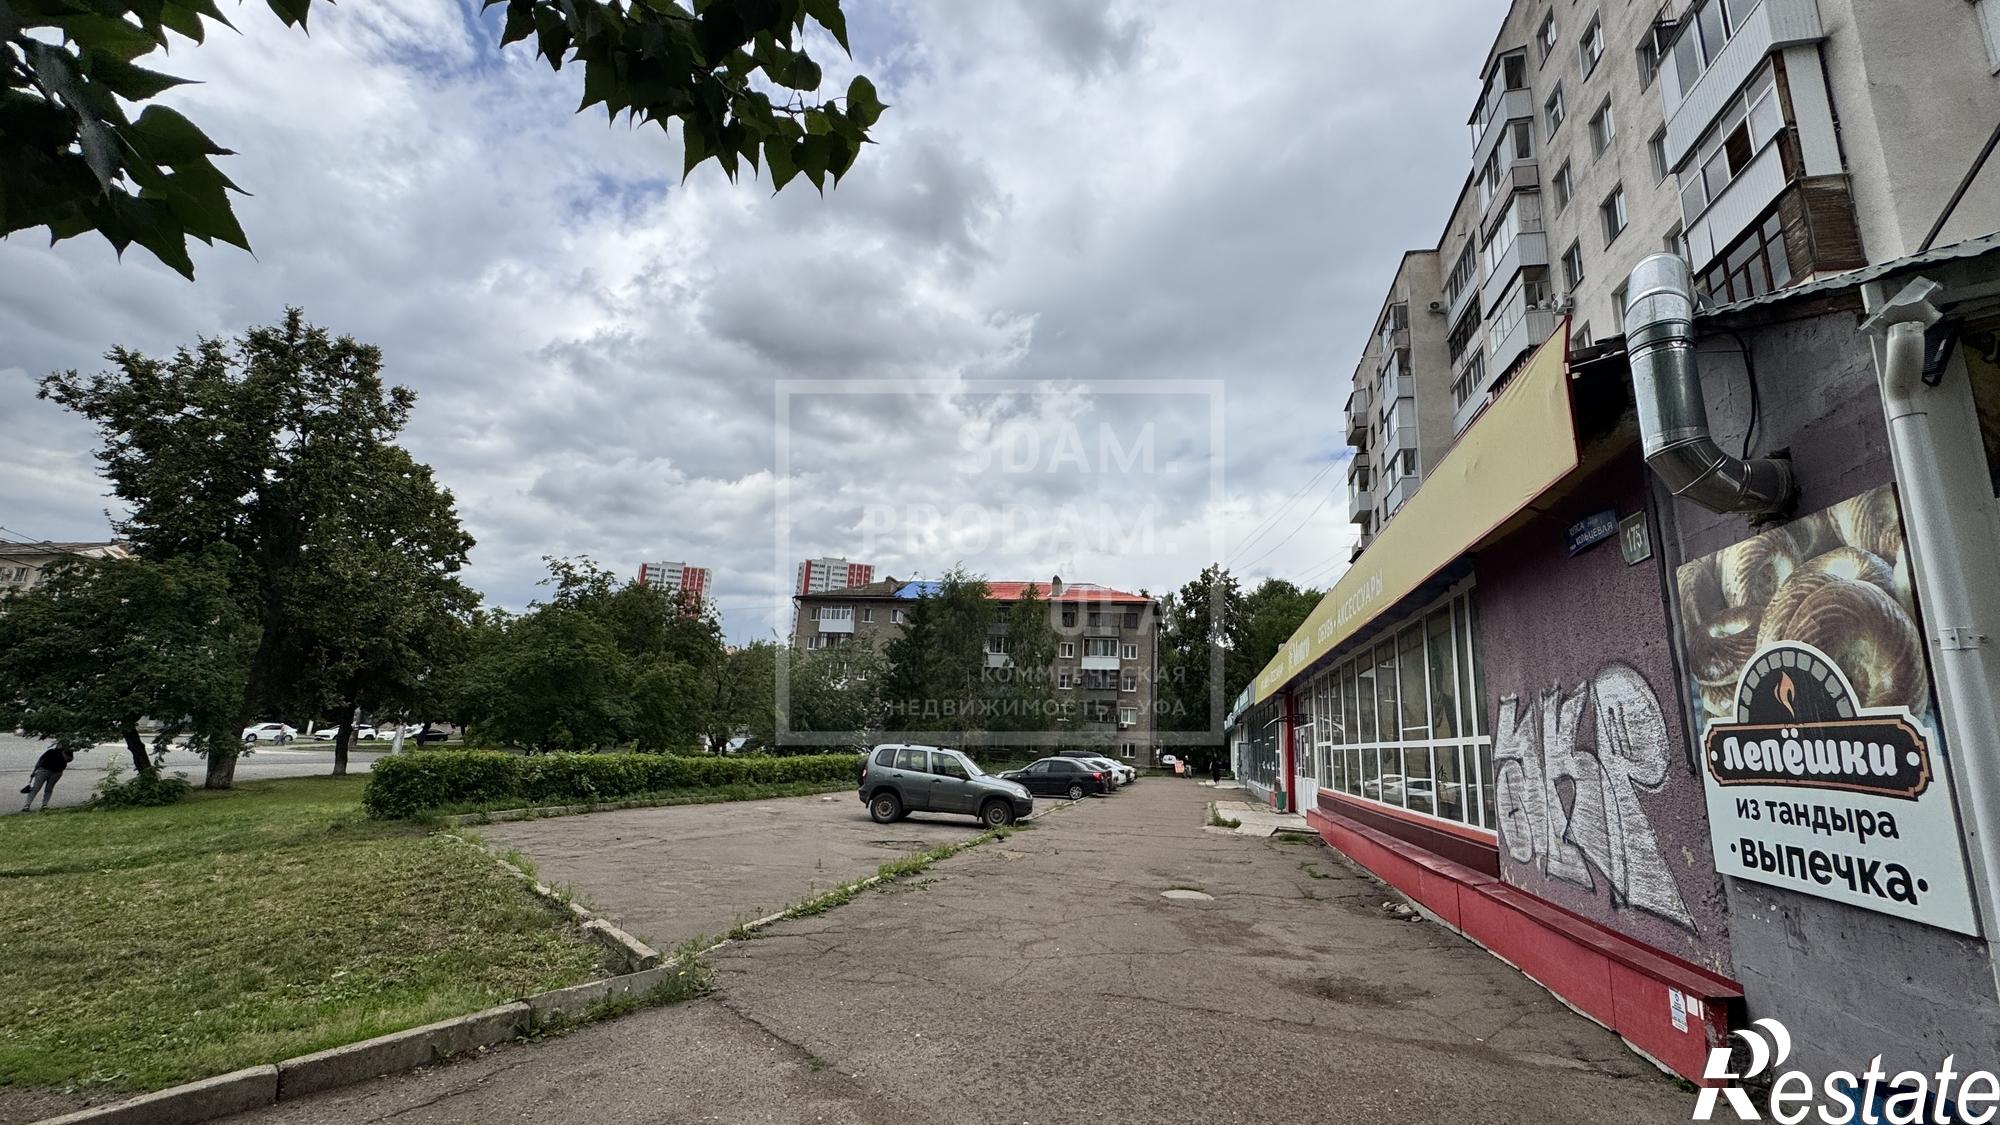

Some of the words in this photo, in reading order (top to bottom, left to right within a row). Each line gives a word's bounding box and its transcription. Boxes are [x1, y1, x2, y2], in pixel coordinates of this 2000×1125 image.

[1723, 728, 1898, 776] Лепёшки
[1735, 797, 1761, 821] из
[1765, 800, 1900, 844] тандыра
